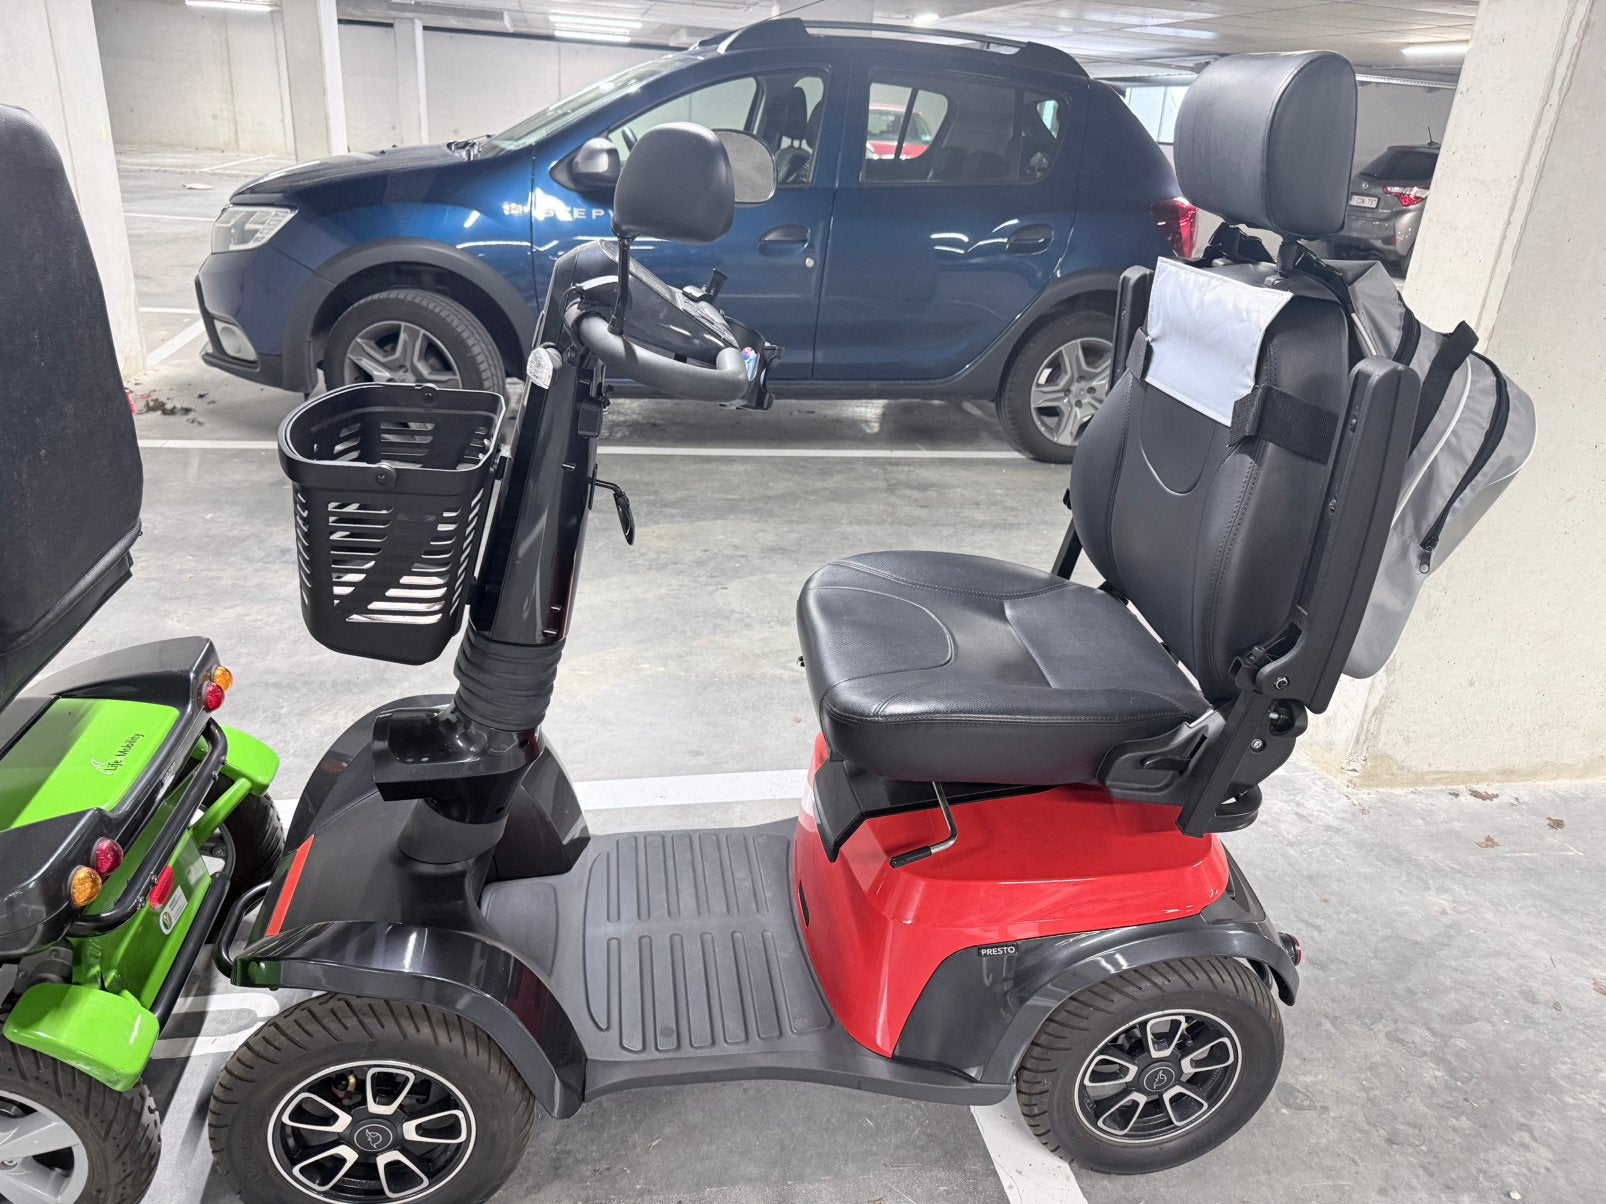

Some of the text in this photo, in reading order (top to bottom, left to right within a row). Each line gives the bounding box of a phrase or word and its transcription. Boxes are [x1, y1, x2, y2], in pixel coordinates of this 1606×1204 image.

[104, 733, 145, 771] Life Mobility
[981, 946, 1016, 956] PRESTO
